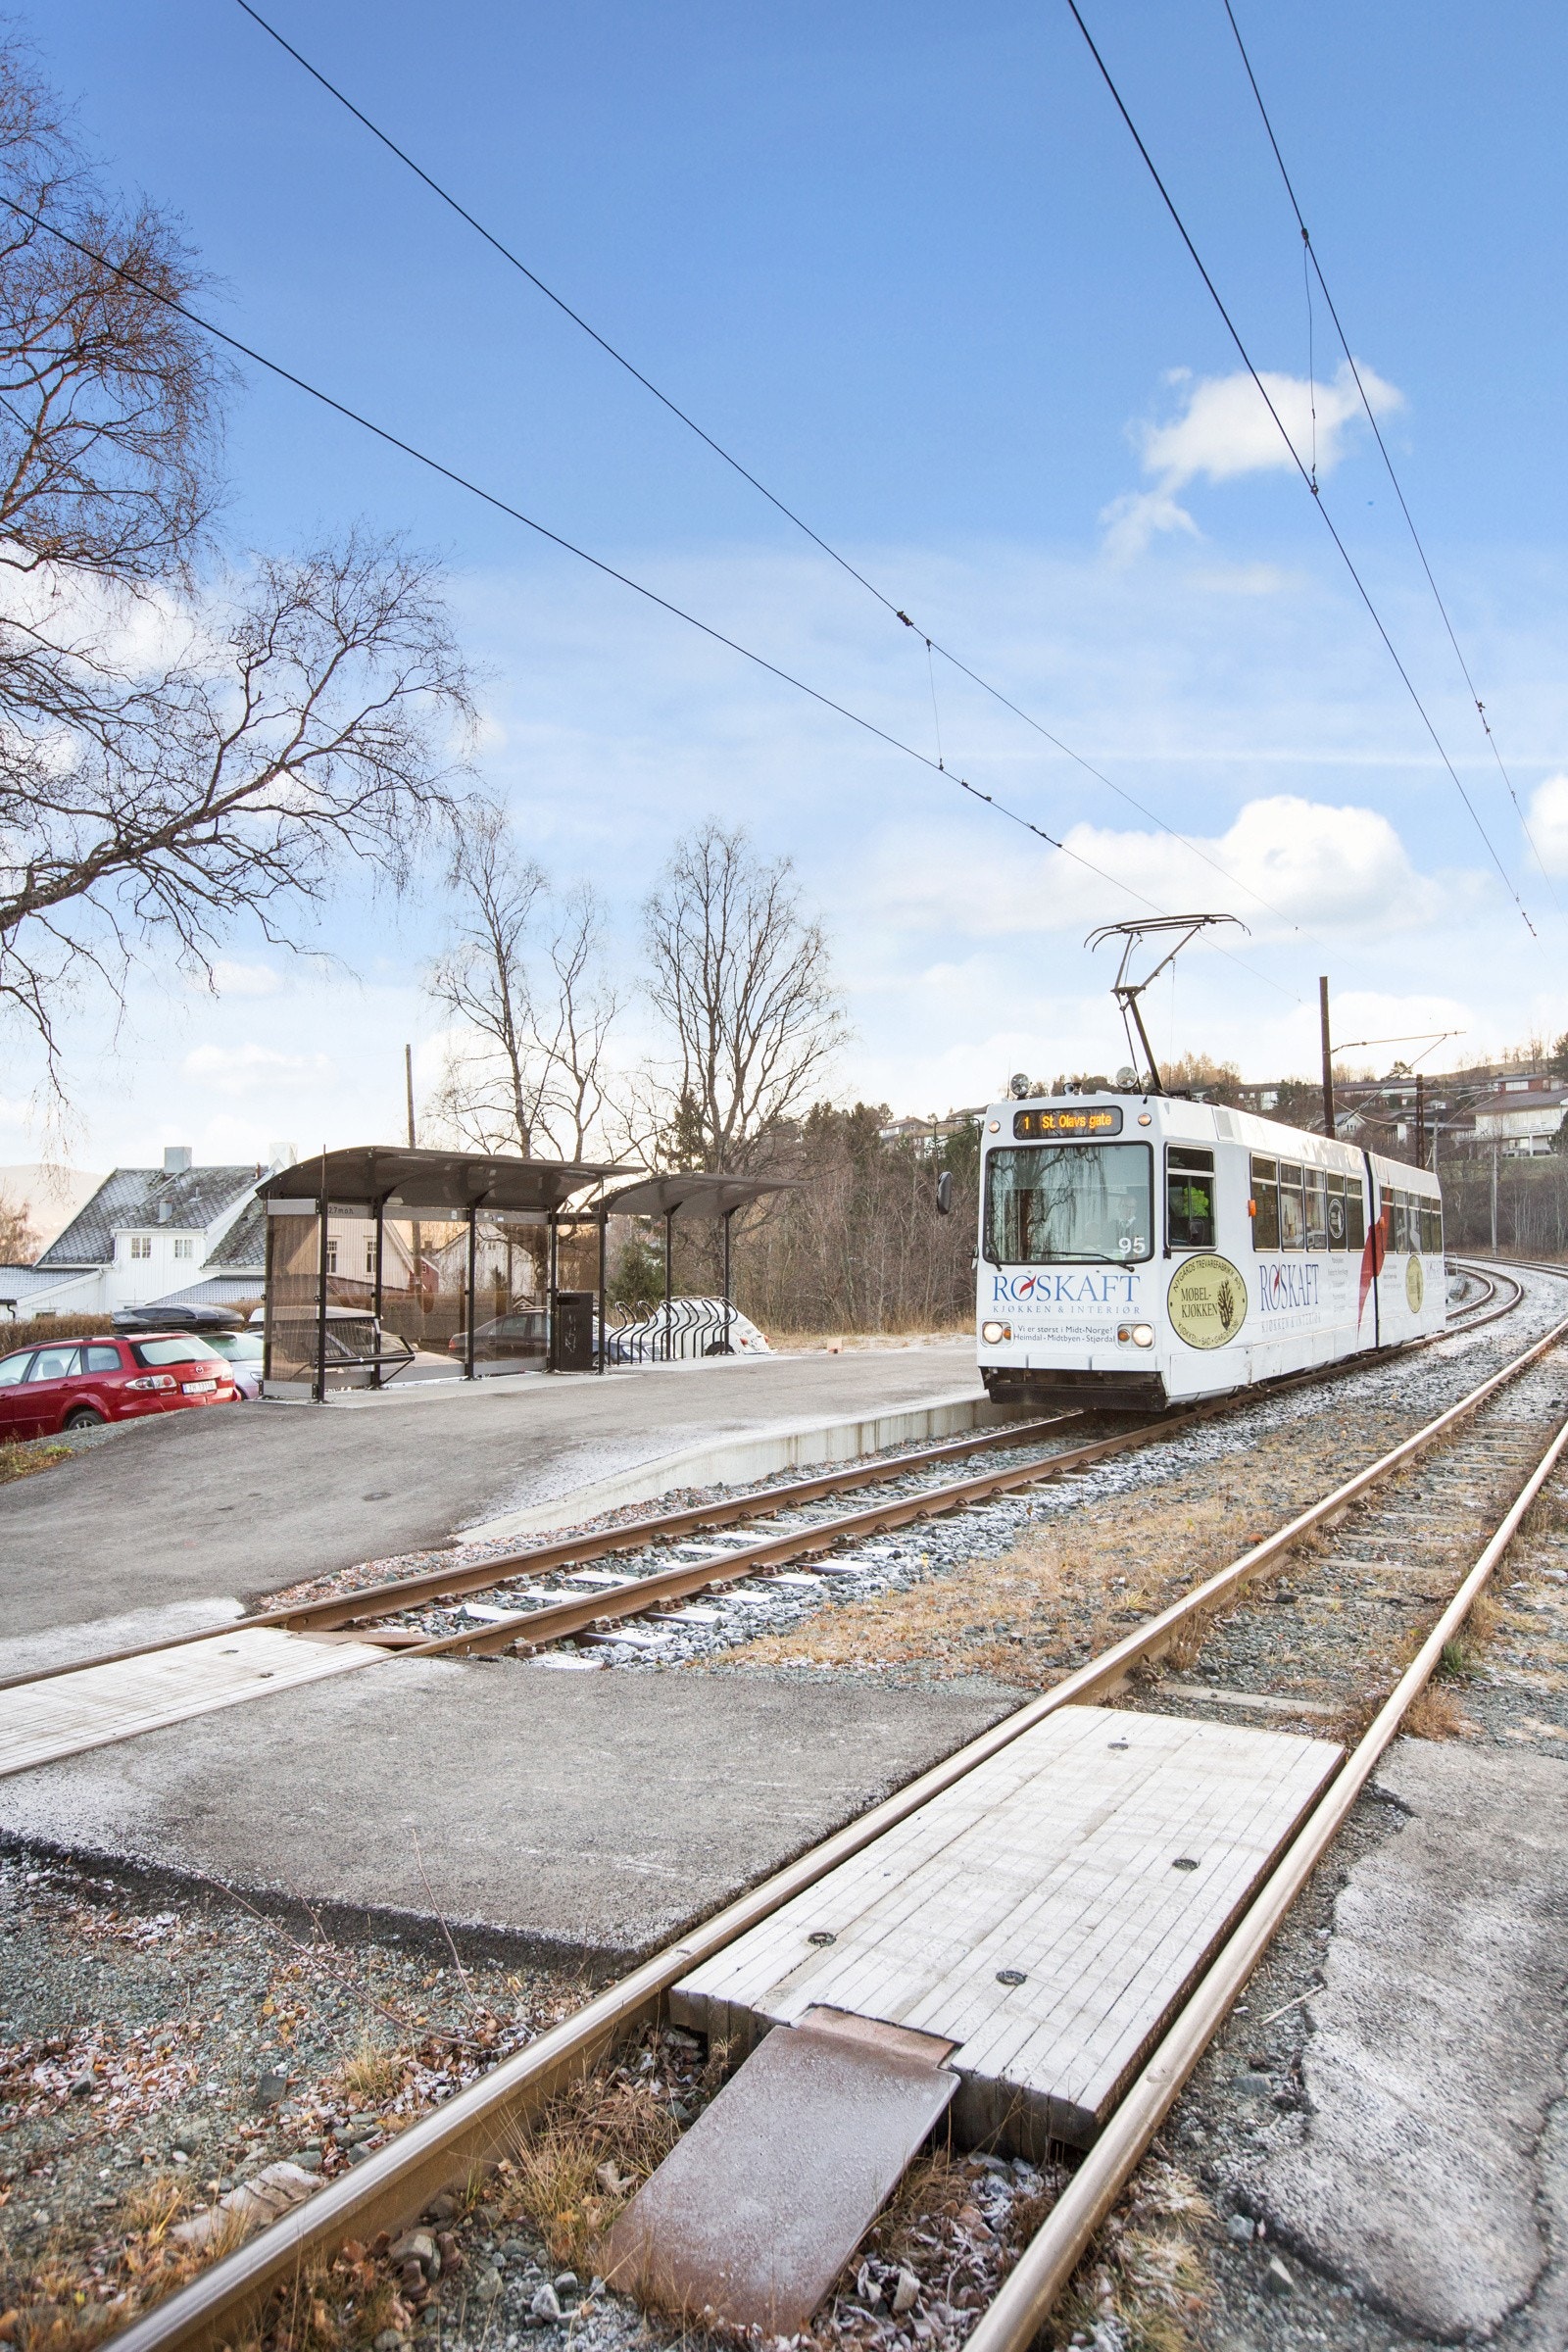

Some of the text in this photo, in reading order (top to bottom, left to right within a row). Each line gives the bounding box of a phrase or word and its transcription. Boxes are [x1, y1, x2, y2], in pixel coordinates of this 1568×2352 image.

[1024, 1113, 1112, 1130] 1 St. Olavs gate
[1118, 1237, 1146, 1254] 95
[993, 1305, 1052, 1314] KJØKKEN
[1071, 1305, 1141, 1314] INTERIØR
[1047, 1334, 1081, 1344] Midtbyen
[1086, 1335, 1115, 1344] Stjørdal
